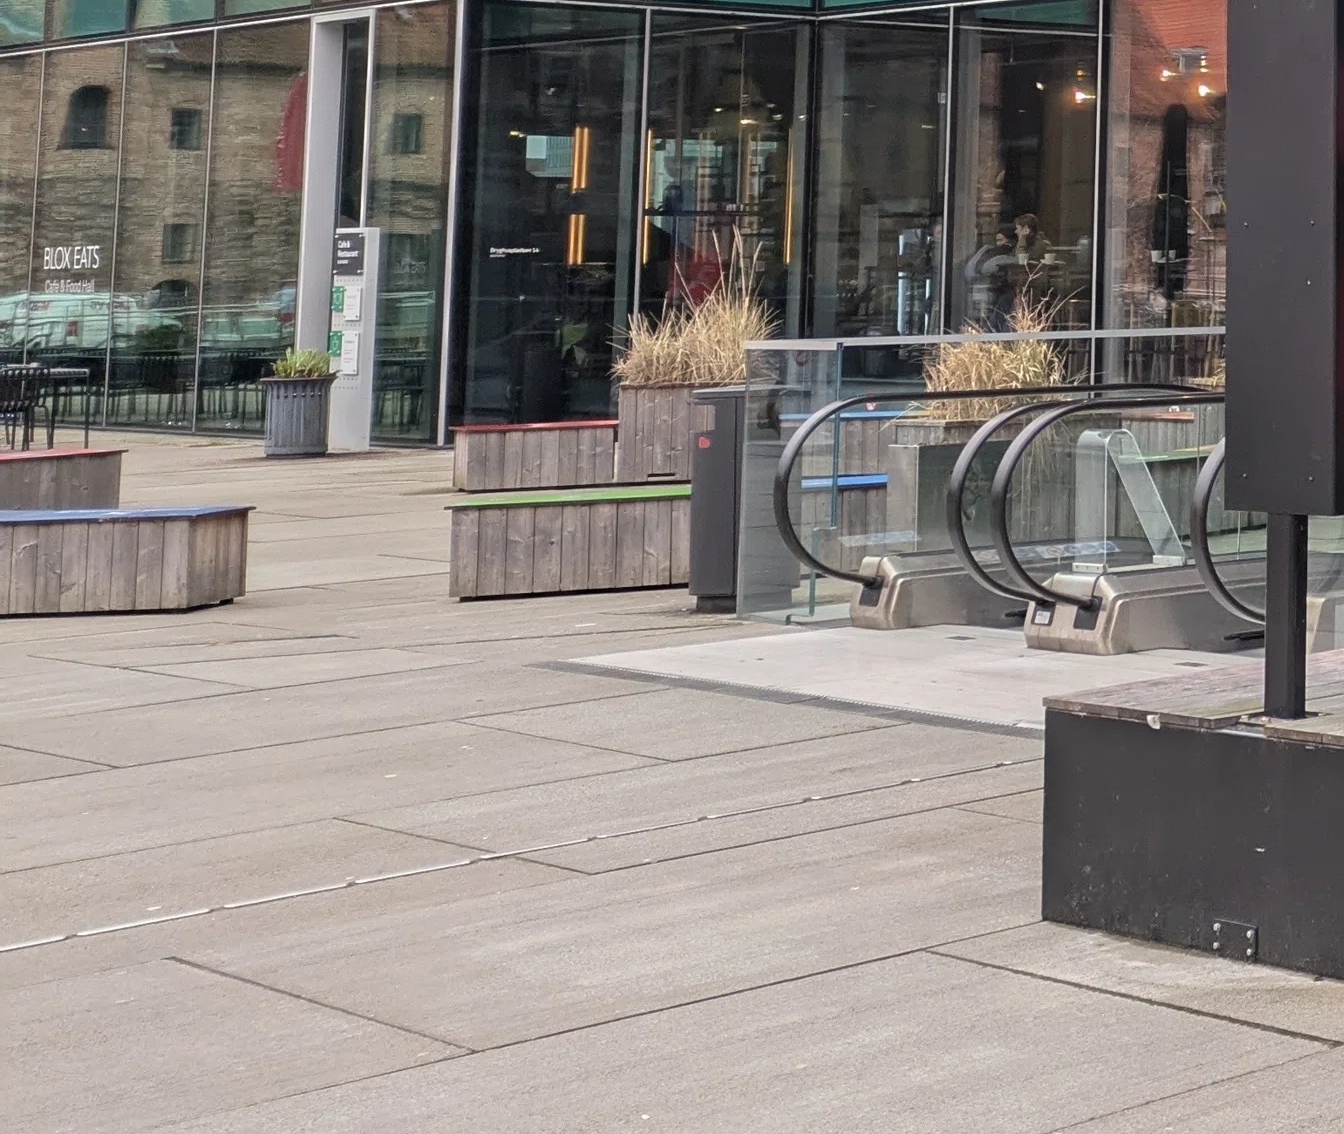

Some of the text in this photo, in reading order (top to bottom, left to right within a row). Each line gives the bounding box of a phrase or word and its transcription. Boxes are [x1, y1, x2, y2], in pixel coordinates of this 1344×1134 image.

[43, 245, 100, 270] BLOX EATS
[65, 279, 81, 293] Food
